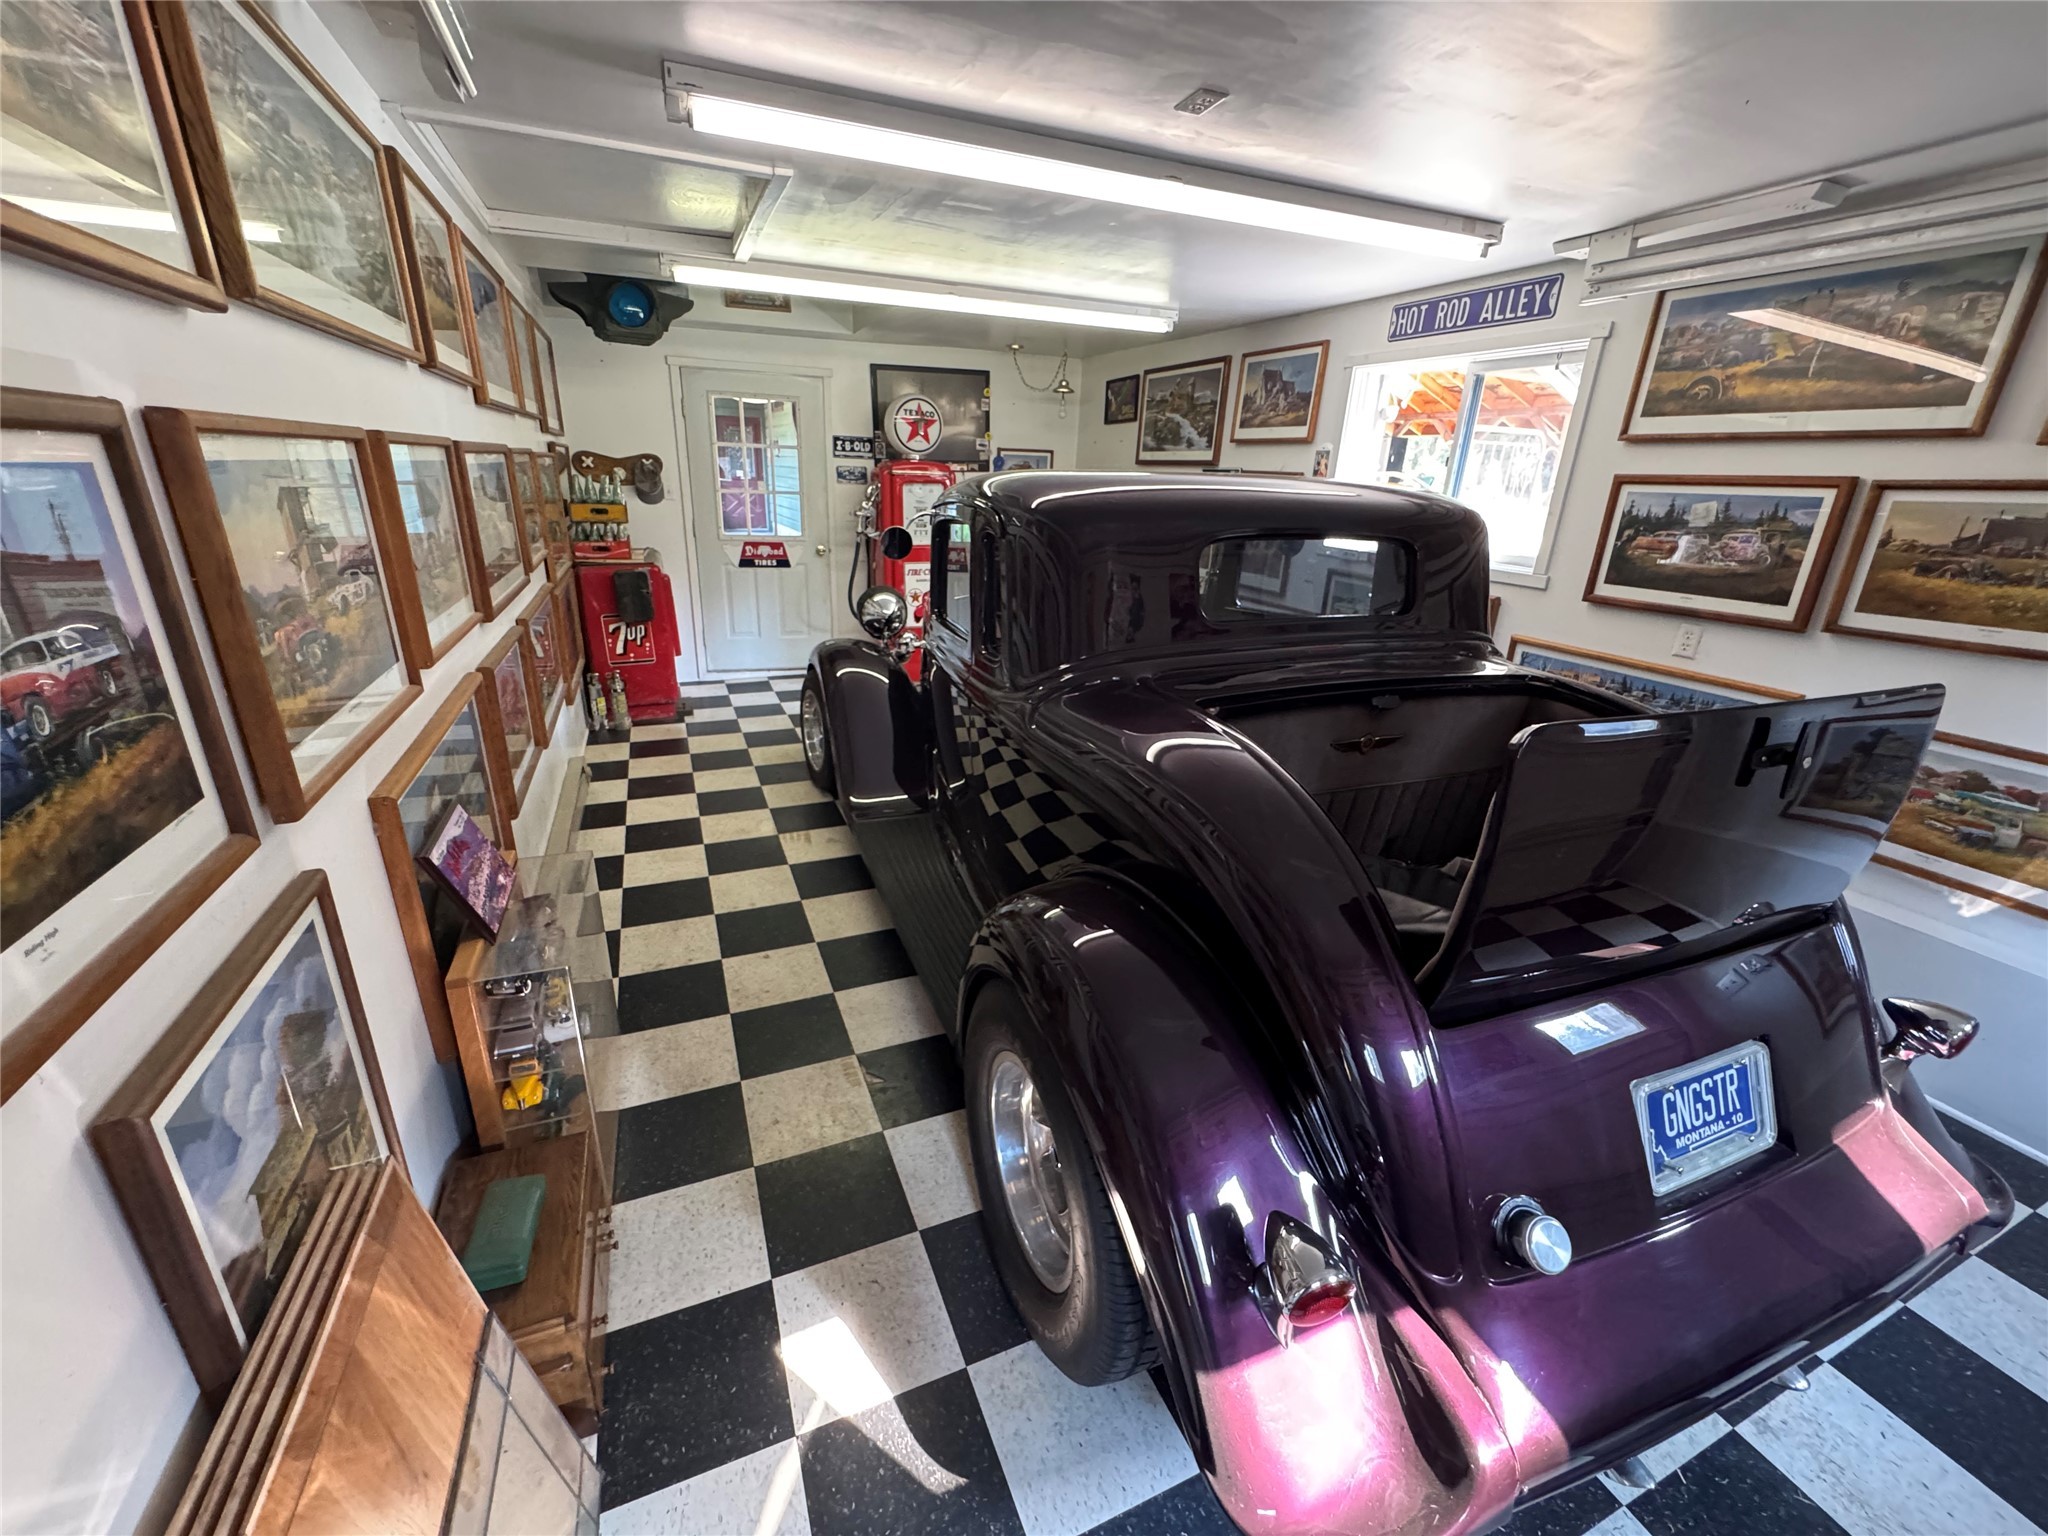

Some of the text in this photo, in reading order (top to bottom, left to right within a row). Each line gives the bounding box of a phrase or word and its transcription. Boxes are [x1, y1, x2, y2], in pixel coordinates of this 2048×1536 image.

[1395, 282, 1549, 336] HOT ROD ALLEY
[903, 408, 935, 418] TEXACO
[907, 568, 931, 576] FIRE-C
[1662, 1068, 1741, 1137] GNGSTR
[1675, 1120, 1725, 1149] MONTANA
[1731, 1112, 1744, 1124] 10
